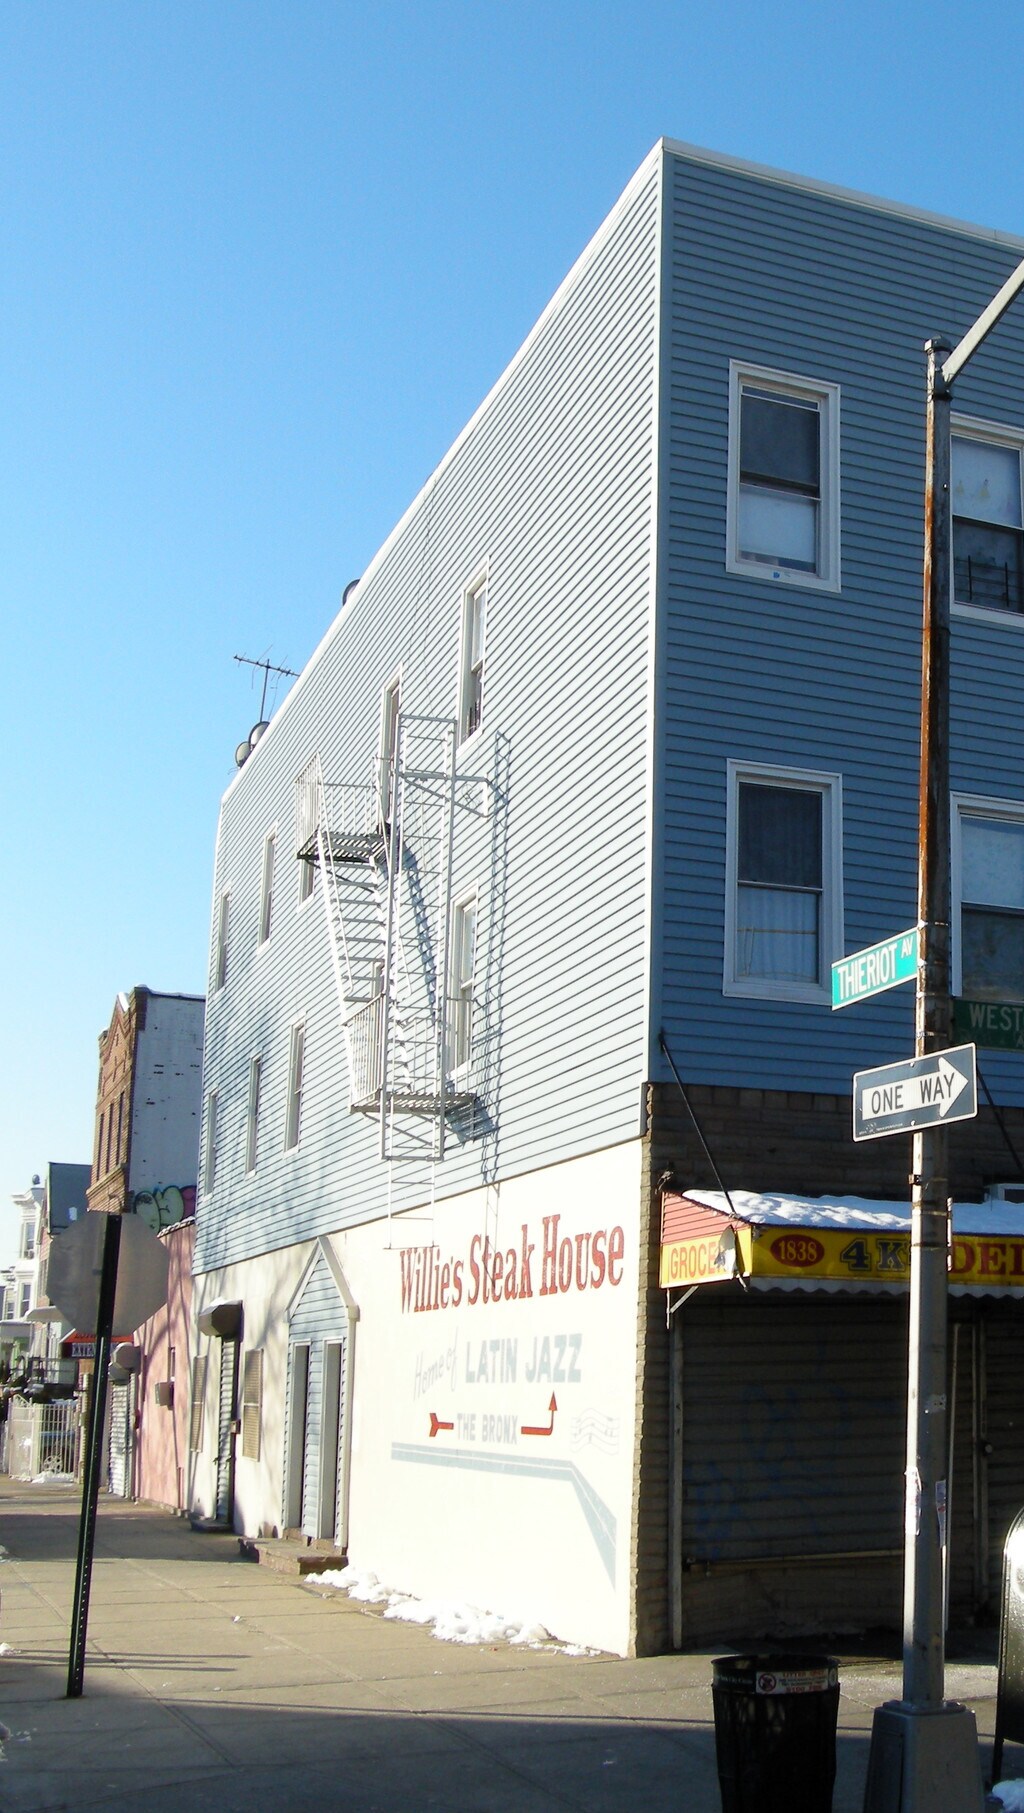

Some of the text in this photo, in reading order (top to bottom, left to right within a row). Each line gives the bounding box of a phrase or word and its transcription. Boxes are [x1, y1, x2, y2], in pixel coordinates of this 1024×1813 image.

[837, 934, 913, 999] THIERIOT AV
[871, 1072, 956, 1115] ONE WAY
[400, 1214, 625, 1314] Willie's Steak House
[671, 1241, 726, 1280] GROCE
[778, 1240, 818, 1262] 1838
[840, 1238, 871, 1271] 4
[877, 1238, 911, 1272] K'
[413, 1326, 583, 1400] Home of LATIN JAZZ
[457, 1412, 519, 1446] THE BRONX
